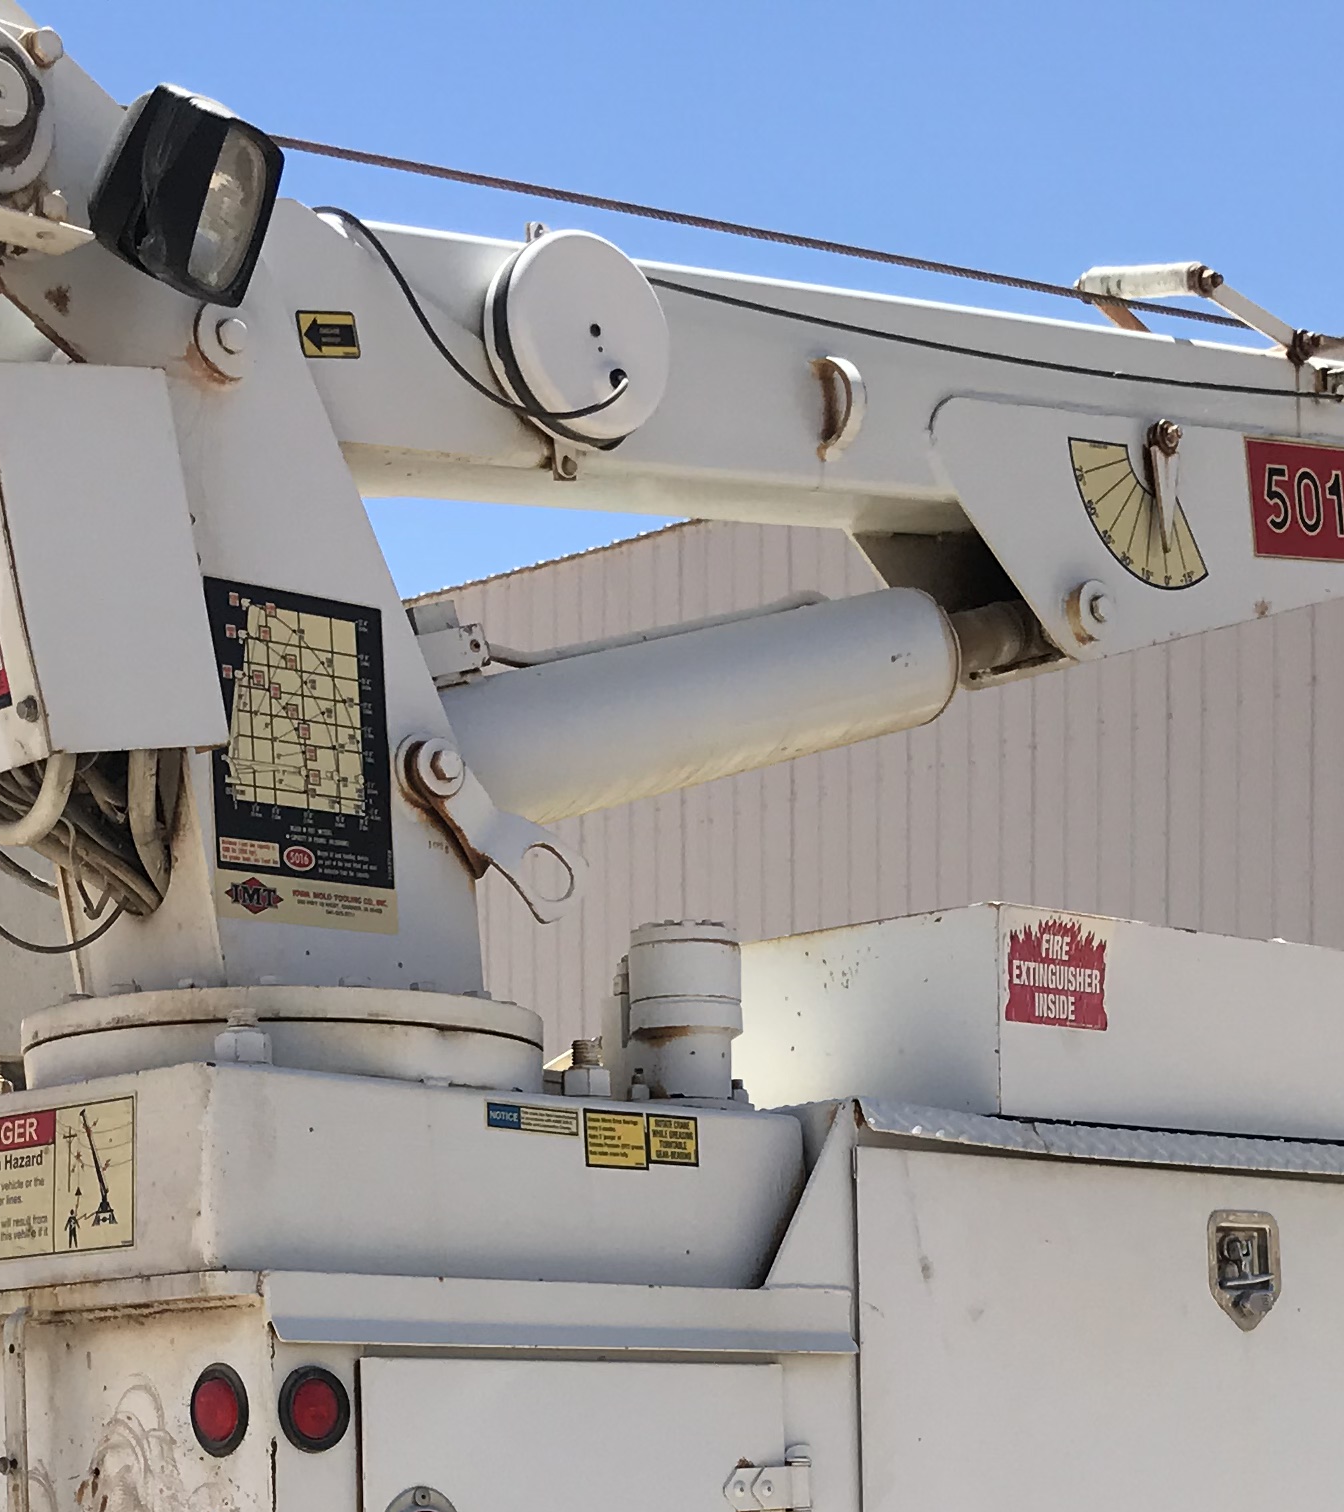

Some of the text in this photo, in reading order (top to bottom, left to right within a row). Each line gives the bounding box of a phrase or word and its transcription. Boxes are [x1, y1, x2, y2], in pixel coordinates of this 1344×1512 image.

[290, 852, 309, 865] 5016
[231, 882, 278, 909] IMT
[1042, 933, 1071, 960] FIRE
[1012, 960, 1101, 994] EXTINGUISHER
[1035, 992, 1075, 1020] INSIDE
[489, 1110, 519, 1122] NOTICE
[4, 1150, 43, 1172] Hazard
[1, 1180, 23, 1191] vehicle
[25, 1179, 32, 1187] or
[34, 1177, 44, 1187] the
